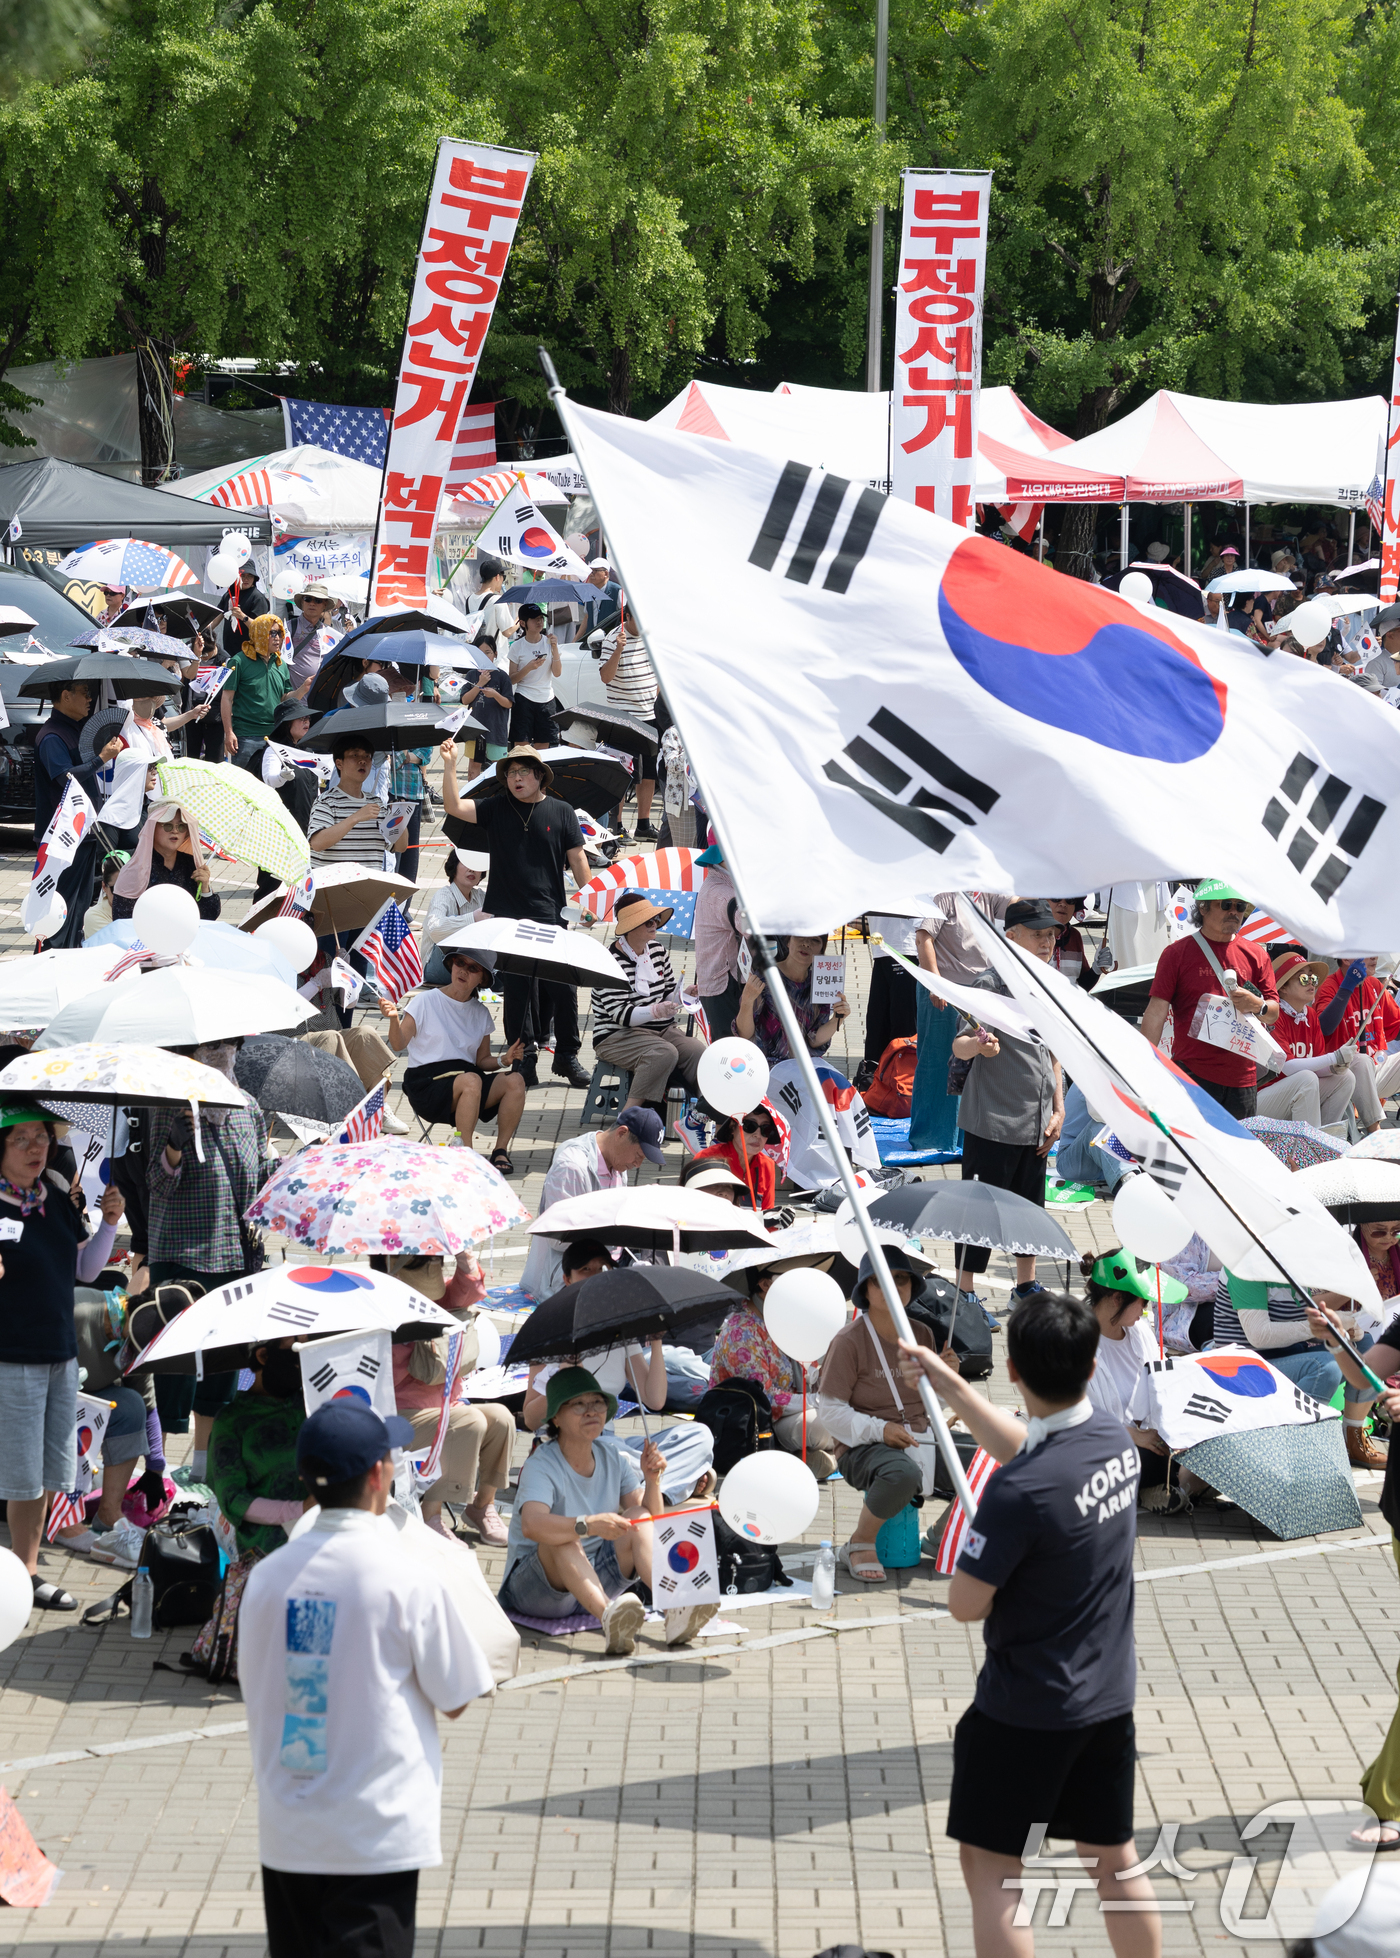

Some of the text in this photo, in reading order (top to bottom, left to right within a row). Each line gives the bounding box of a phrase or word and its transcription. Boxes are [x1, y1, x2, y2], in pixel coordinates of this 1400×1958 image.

[899, 189, 981, 459] 부정선거
[375, 157, 528, 609] 부정선거 척결
[1021, 483, 1111, 497] 자유대한국민연대
[1141, 481, 1230, 497] 자유대한국민연대
[306, 539, 340, 552] 선거는
[22, 547, 44, 564] 6.3
[286, 551, 361, 570] 자유민주주의
[1098, 1479, 1137, 1524] ARMY
